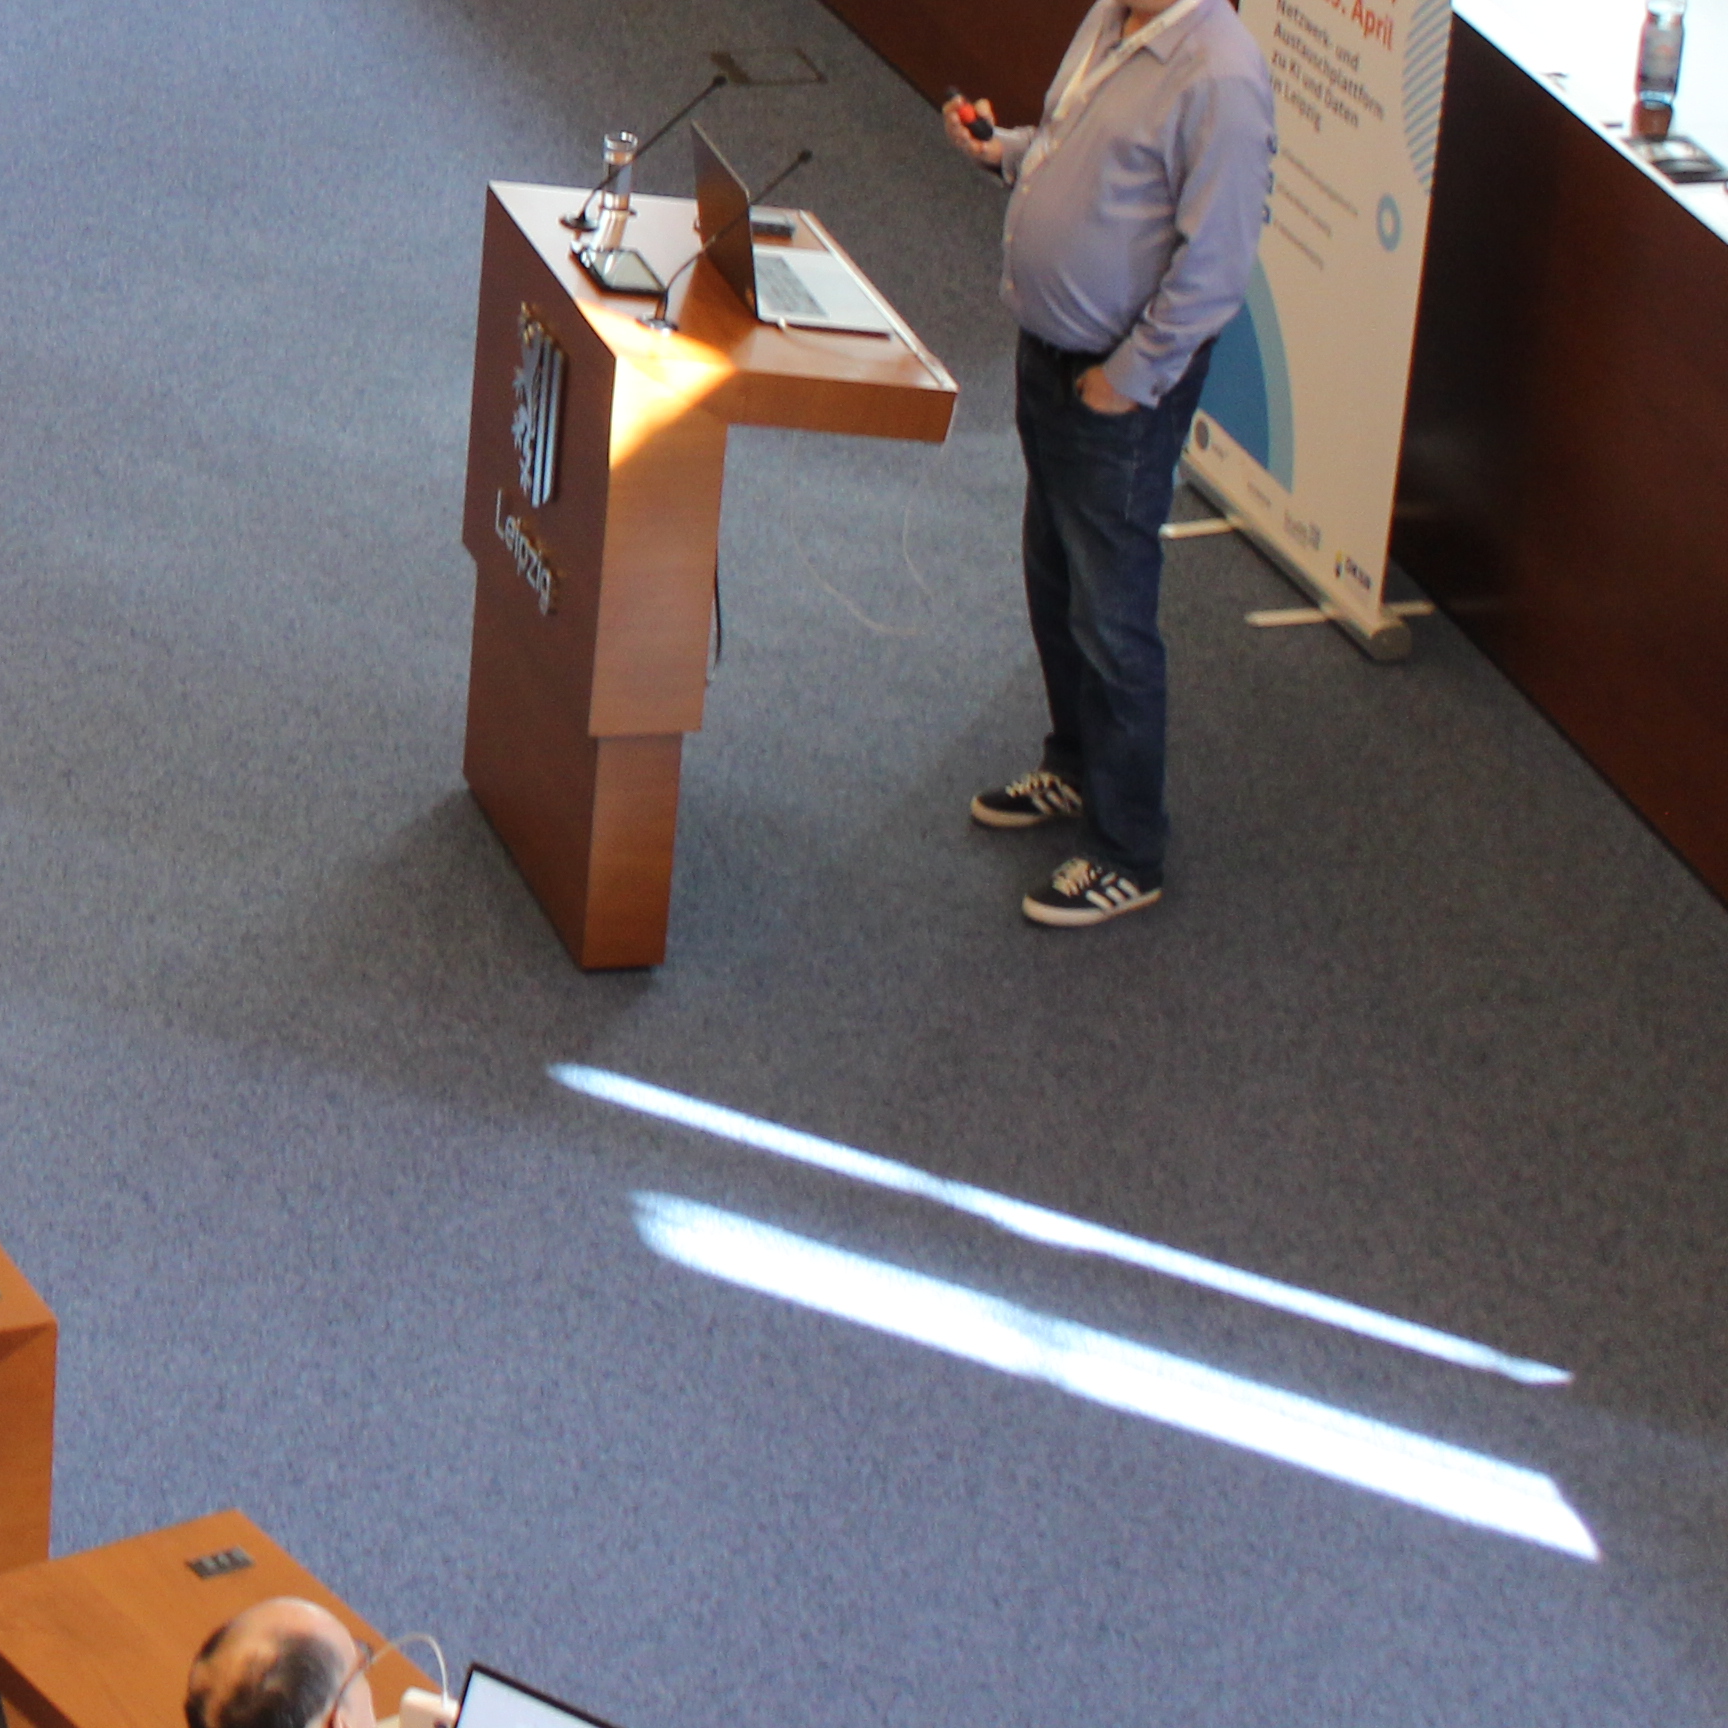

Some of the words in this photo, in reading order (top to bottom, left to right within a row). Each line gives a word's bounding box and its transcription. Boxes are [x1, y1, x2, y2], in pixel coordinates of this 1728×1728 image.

[1271, 48, 1287, 69] zu
[1301, 73, 1323, 100] und
[1324, 87, 1359, 129] Daten
[1273, 20, 1385, 121] Austauschplattform
[1334, 45, 1360, 73] und
[1282, 83, 1322, 134] Leipzig
[495, 488, 551, 615] Leipzig
